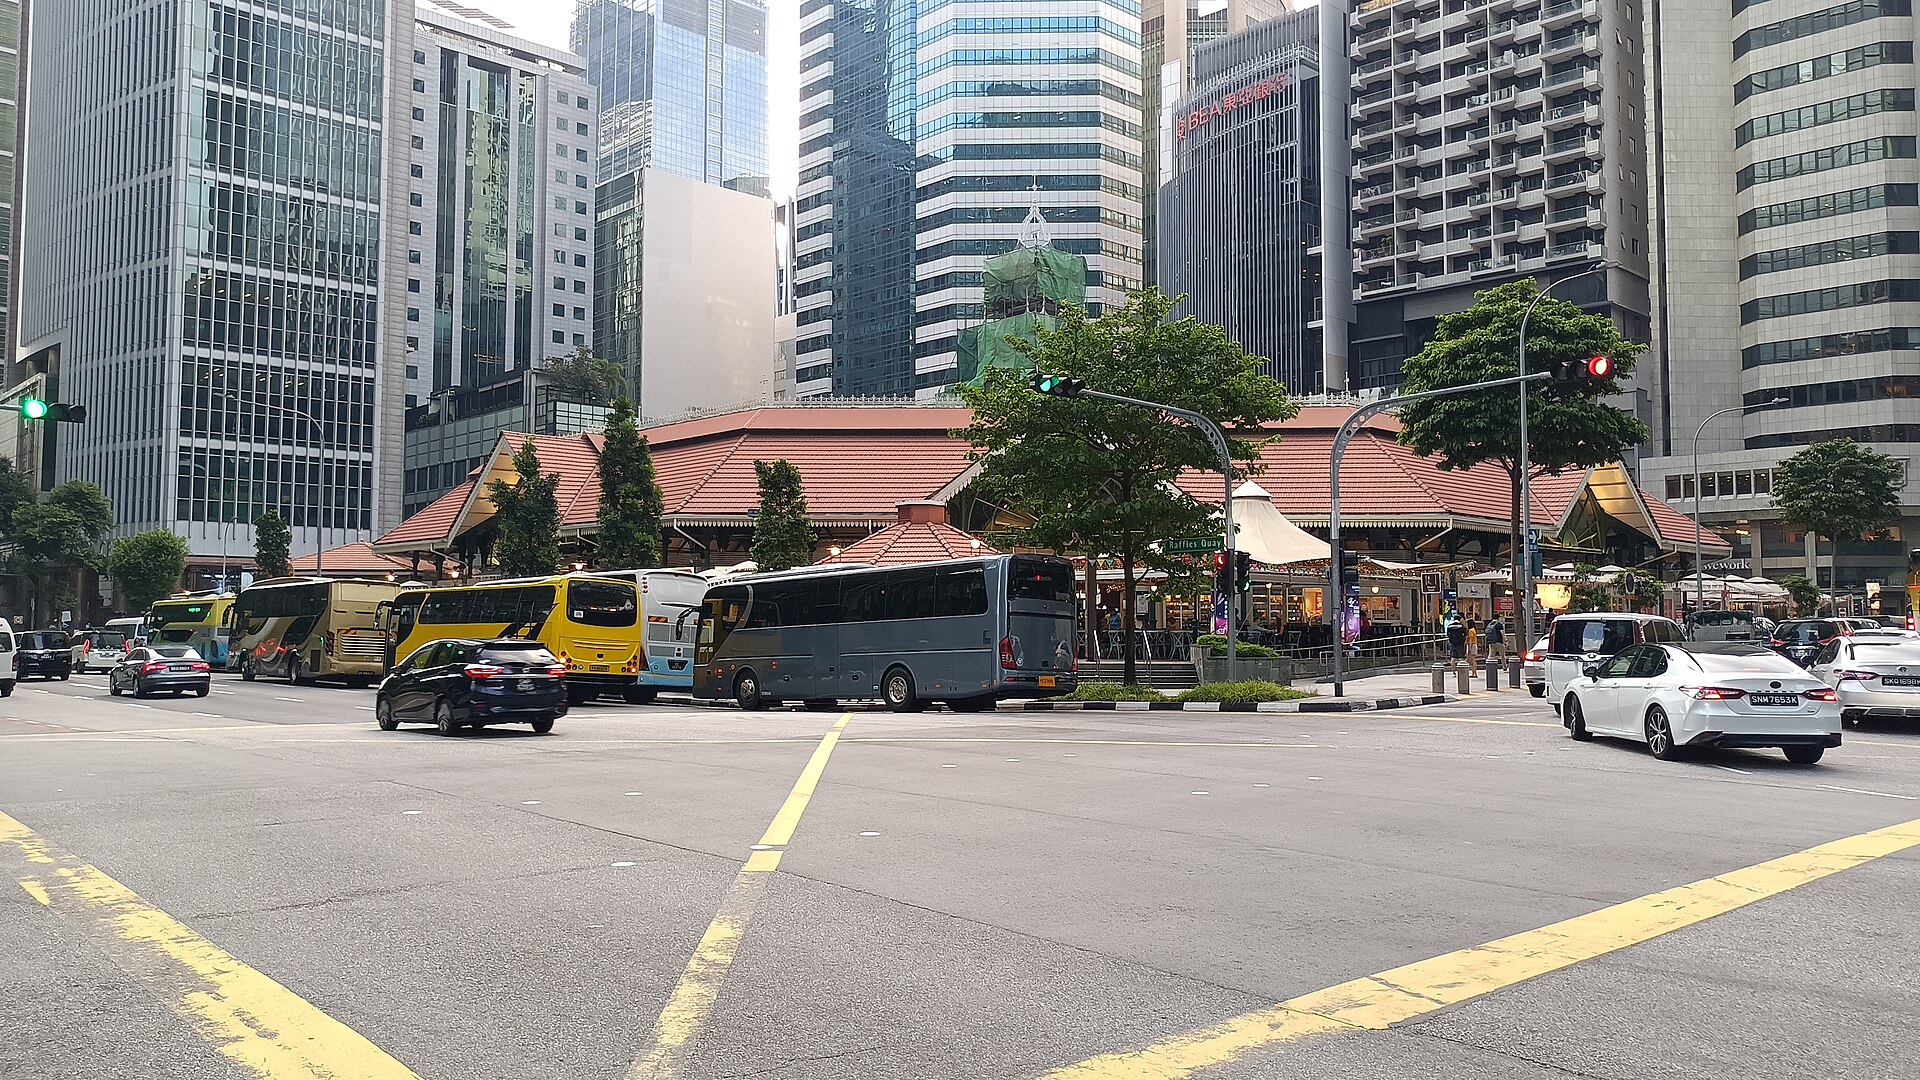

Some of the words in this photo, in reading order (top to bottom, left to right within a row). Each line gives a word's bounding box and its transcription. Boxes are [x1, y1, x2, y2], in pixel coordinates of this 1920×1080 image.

[1188, 101, 1222, 132] BEA
[1169, 540, 1198, 549] Raffles
[1200, 538, 1222, 549] Quay
[1703, 558, 1750, 570] wework
[1751, 695, 1798, 704] SNM7653K
